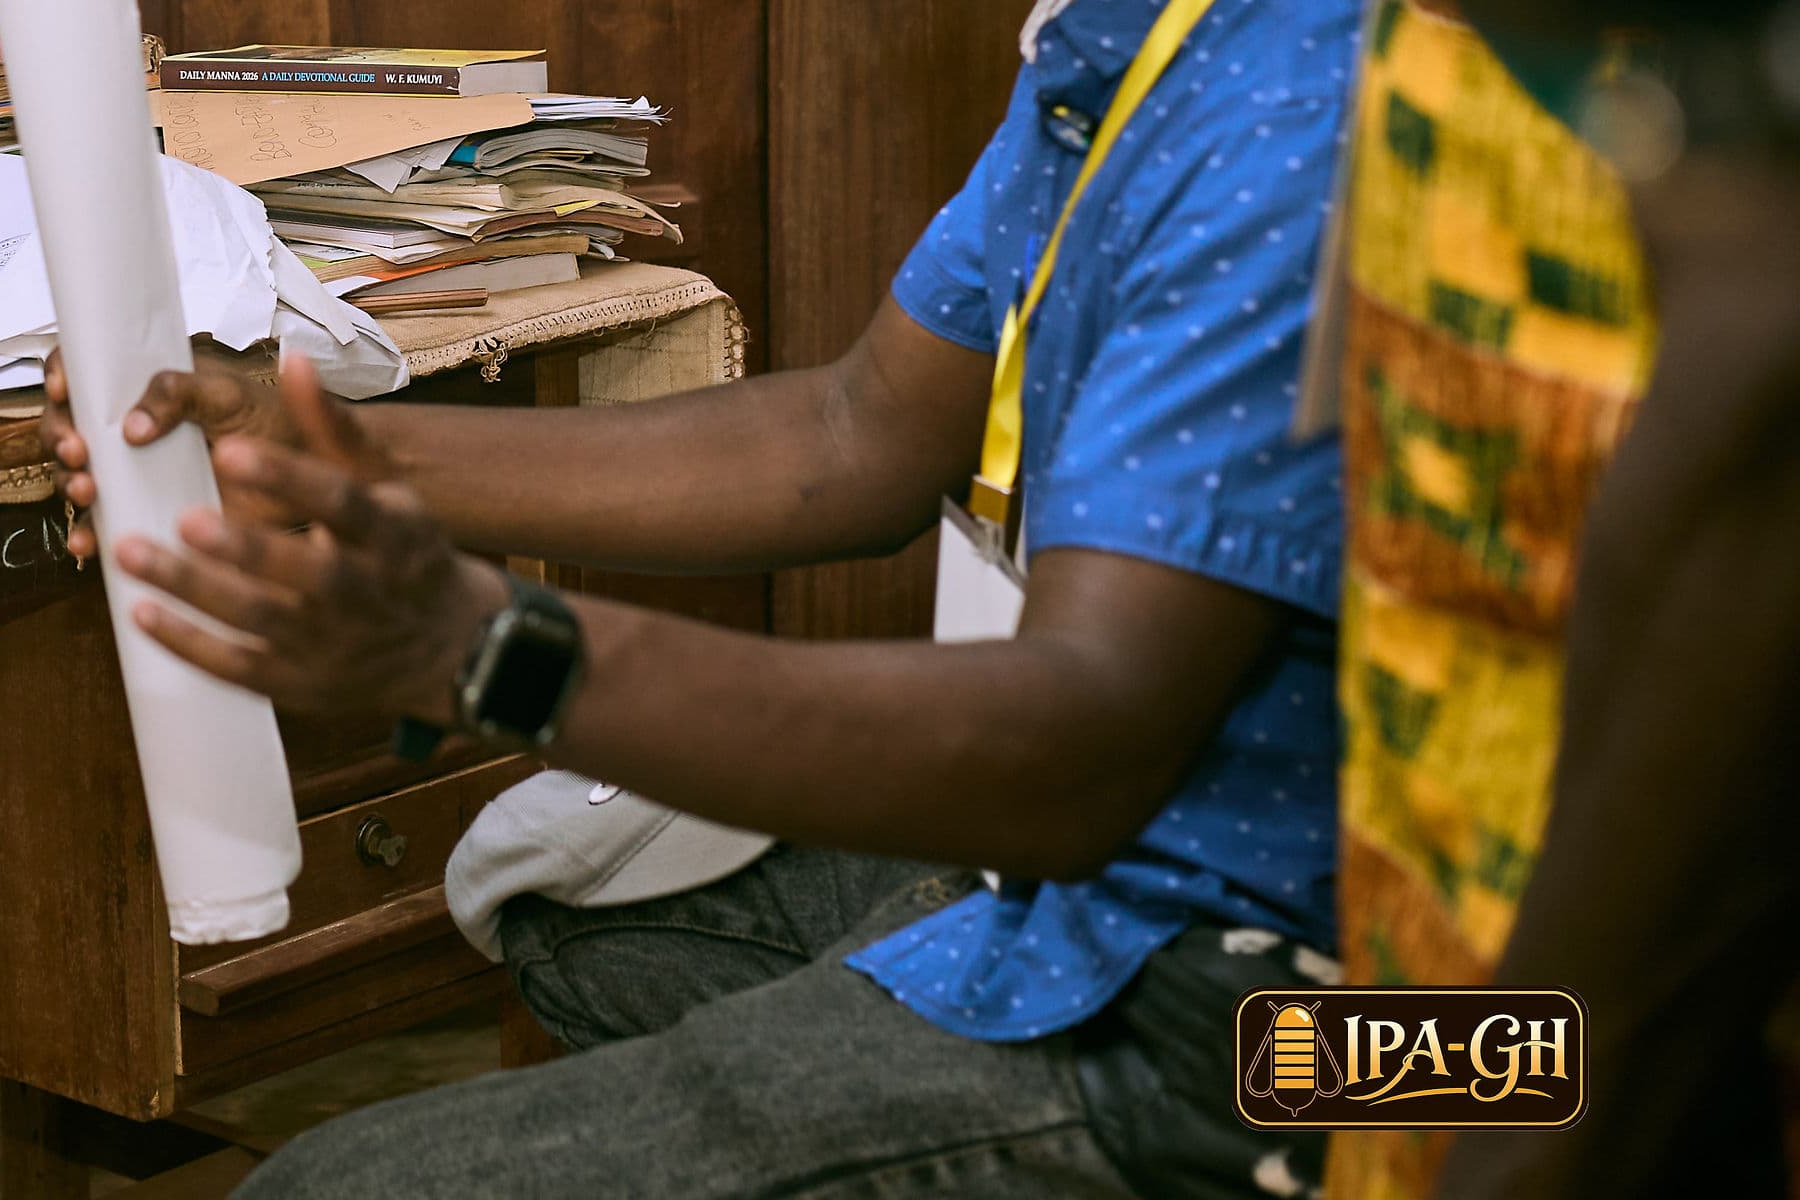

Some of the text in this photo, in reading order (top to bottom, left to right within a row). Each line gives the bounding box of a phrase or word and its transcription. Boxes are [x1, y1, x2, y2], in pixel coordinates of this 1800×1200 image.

[180, 69, 375, 84] DAILY MANNA 2026 A DAILY DEVOTIONAL GUIDE
[385, 73, 397, 84] W.
[406, 73, 443, 85] KUMUYI
